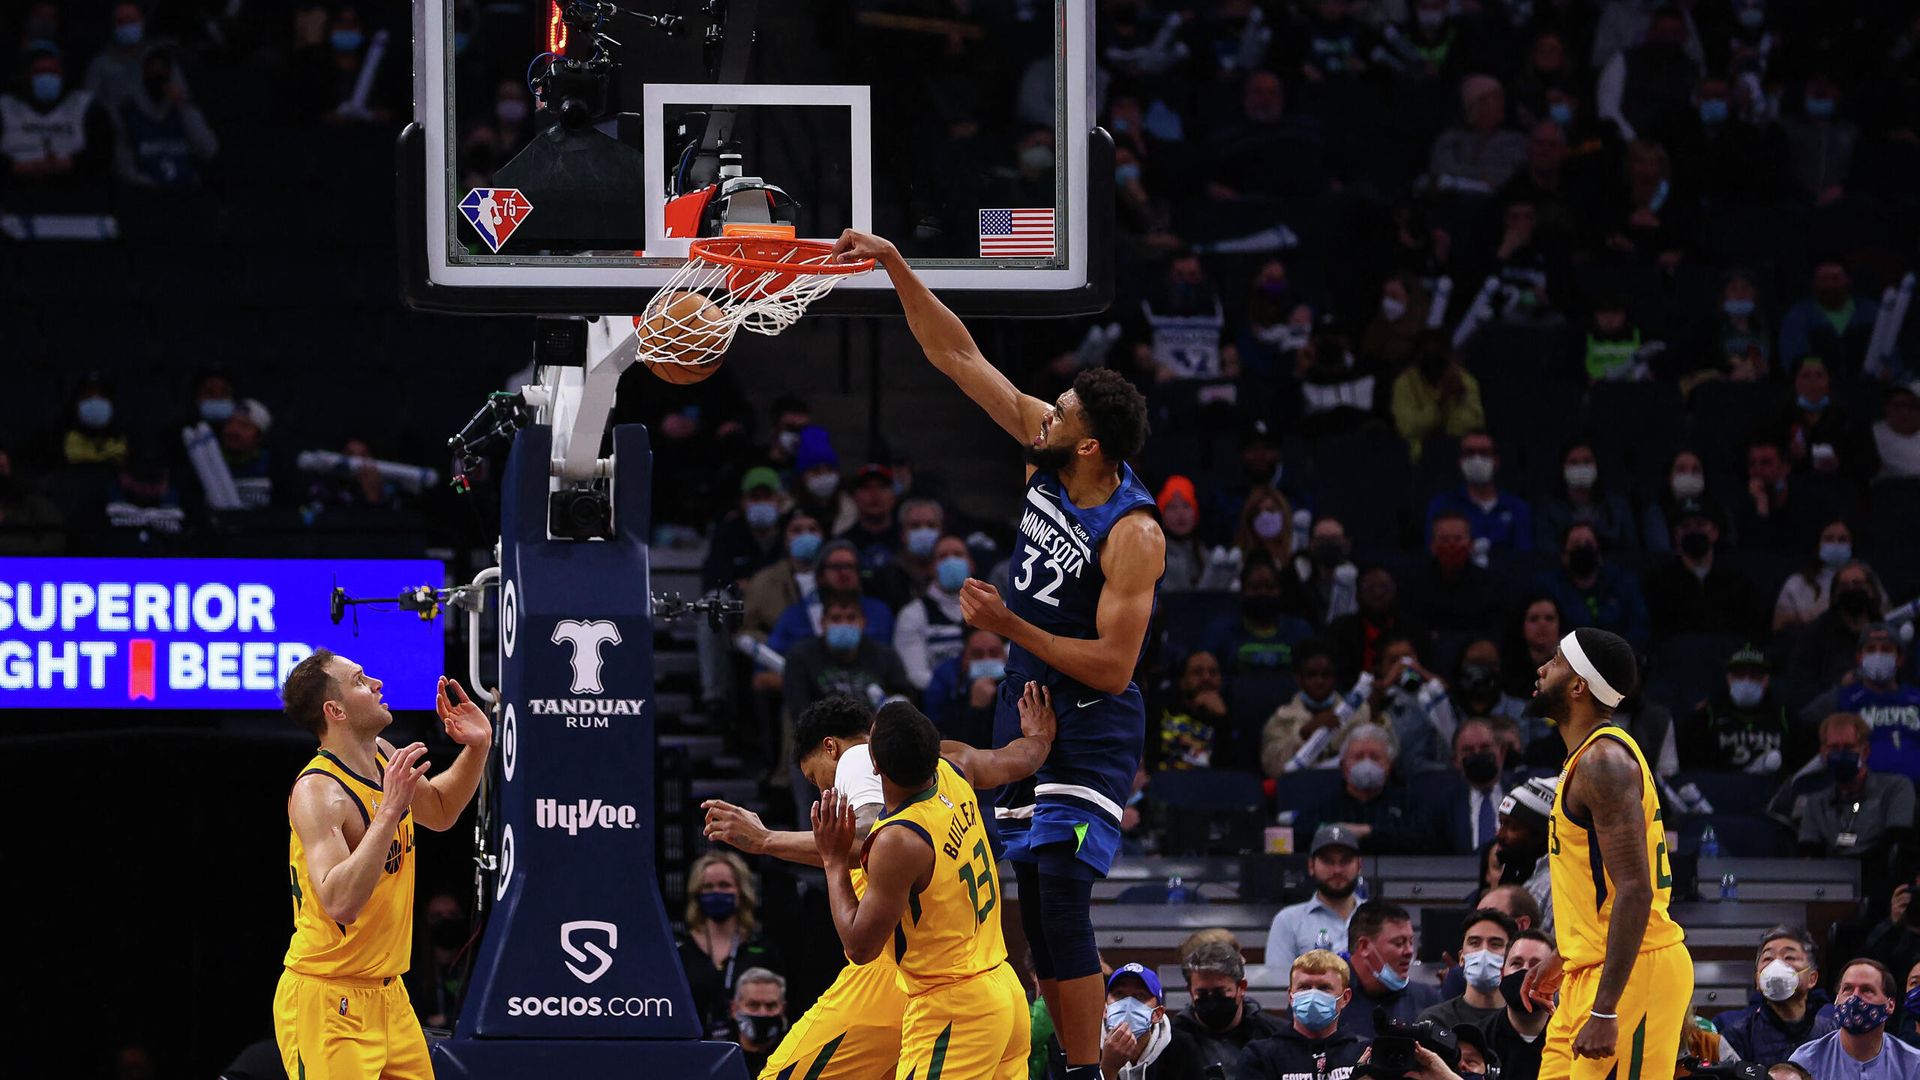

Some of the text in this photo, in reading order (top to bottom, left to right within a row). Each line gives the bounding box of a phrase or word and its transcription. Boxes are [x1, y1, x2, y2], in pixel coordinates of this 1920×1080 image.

[502, 198, 516, 217] 75
[1019, 507, 1084, 579] MINNESOTA
[1014, 544, 1061, 608] 32
[528, 698, 646, 716] TANDUAY
[566, 716, 609, 729] RUM
[943, 801, 976, 860] BUTLER
[958, 838, 996, 925] 13
[507, 996, 673, 1017] SOCIOS.com
